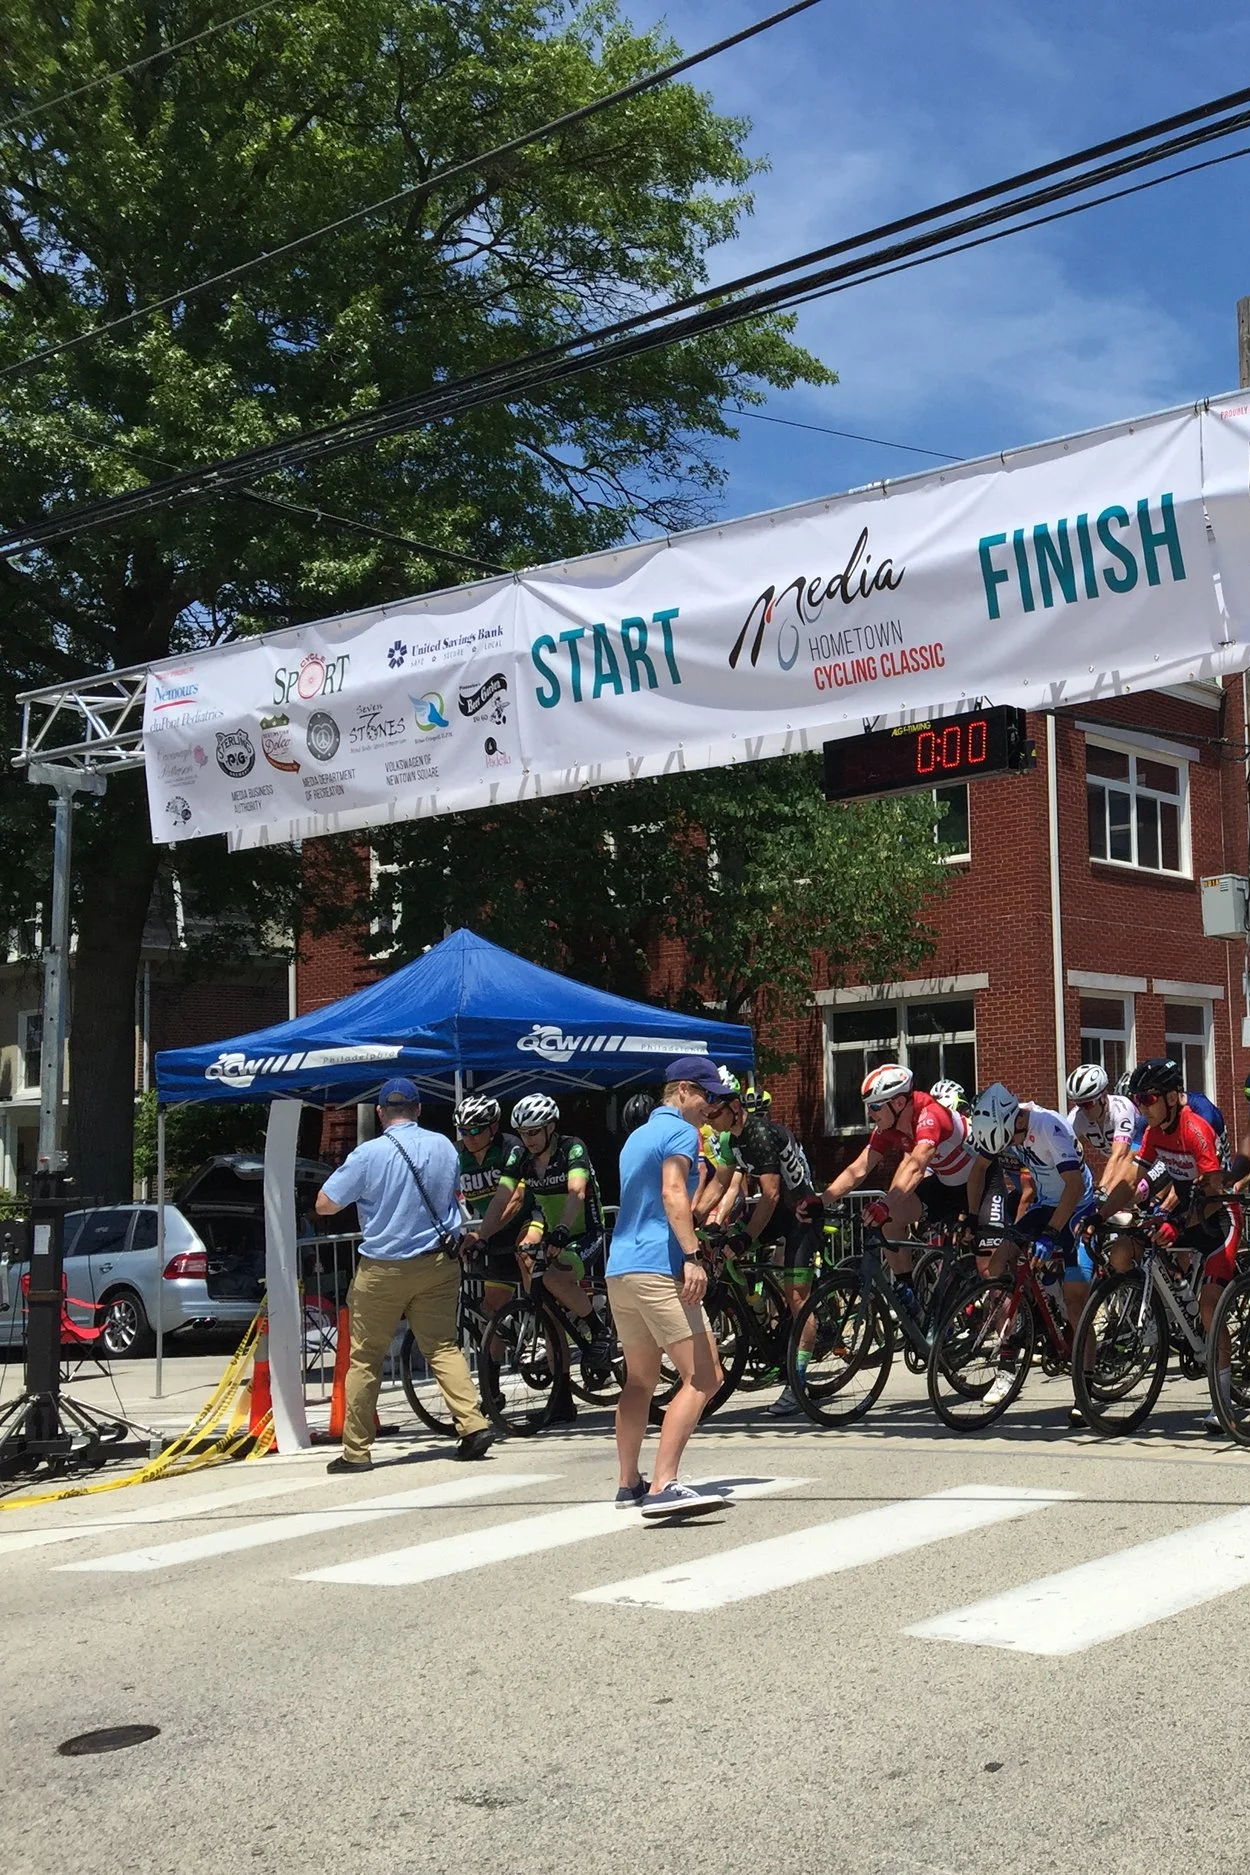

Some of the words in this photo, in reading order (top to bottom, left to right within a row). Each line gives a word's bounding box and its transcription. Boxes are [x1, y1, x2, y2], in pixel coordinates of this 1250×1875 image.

[1220, 406, 1248, 420] PROUDLY
[978, 492, 1188, 621] FINISH
[729, 525, 906, 671] Media
[412, 640, 441, 657] United
[442, 633, 476, 650] Savings
[478, 625, 504, 641] Bank
[809, 619, 903, 662] HOMETOWN
[300, 653, 326, 668] CYCLE
[531, 607, 682, 709] START
[813, 649, 877, 691] CYCLING
[880, 642, 946, 682] CLASSIC
[273, 653, 350, 705] SPORT
[153, 683, 199, 702] Nemours
[356, 703, 383, 714] Seven
[349, 717, 406, 744] STONES
[385, 756, 423, 773] VOLKSWAGEN
[424, 753, 432, 765] OF
[302, 776, 320, 788] MEDIA
[319, 769, 355, 784] DEPARTMENT
[386, 771, 416, 786] NEWTOWN
[417, 766, 440, 781] SQUARE
[231, 789, 248, 802] MEDIA
[249, 784, 274, 799] BUSINESS
[305, 790, 313, 801] OF
[313, 785, 345, 800] RECREATION
[234, 800, 262, 814] AUTHORITY
[322, 1051, 396, 1064] Philadelphia
[460, 1167, 502, 1192] GUY'S
[990, 1195, 1001, 1222] UHC
